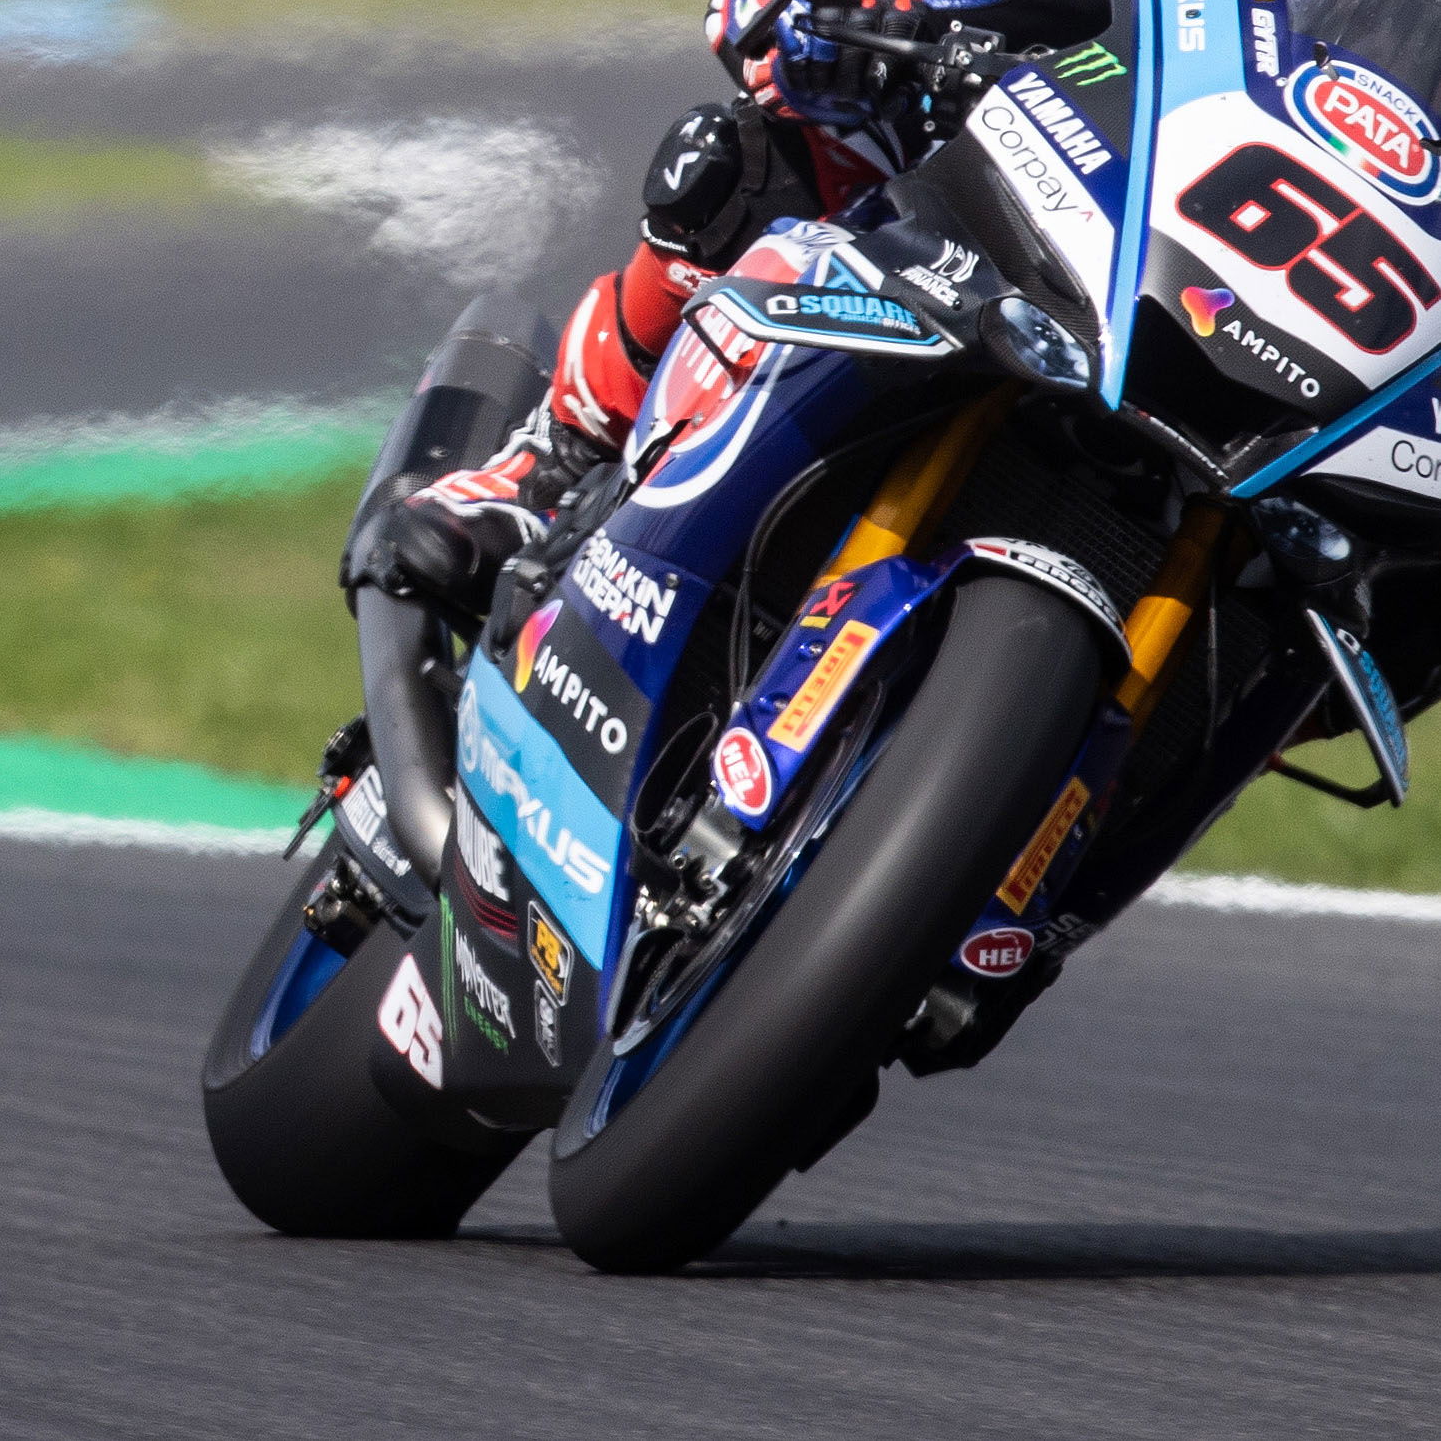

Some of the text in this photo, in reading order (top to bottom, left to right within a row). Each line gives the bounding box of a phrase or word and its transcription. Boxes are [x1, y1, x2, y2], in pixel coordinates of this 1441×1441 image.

[1007, 71, 1112, 176] YAMAHA
[1323, 85, 1413, 169] PATA
[1355, 73, 1421, 125] SNACK
[981, 106, 1079, 212] Corpay
[1175, 141, 1441, 356] 65
[1222, 319, 1321, 399] AMPITO
[534, 645, 628, 755] AMPITO
[782, 631, 867, 740] PIRELLI
[720, 741, 759, 803] HEL
[978, 947, 1024, 967] HEL
[376, 953, 443, 1091] 65
